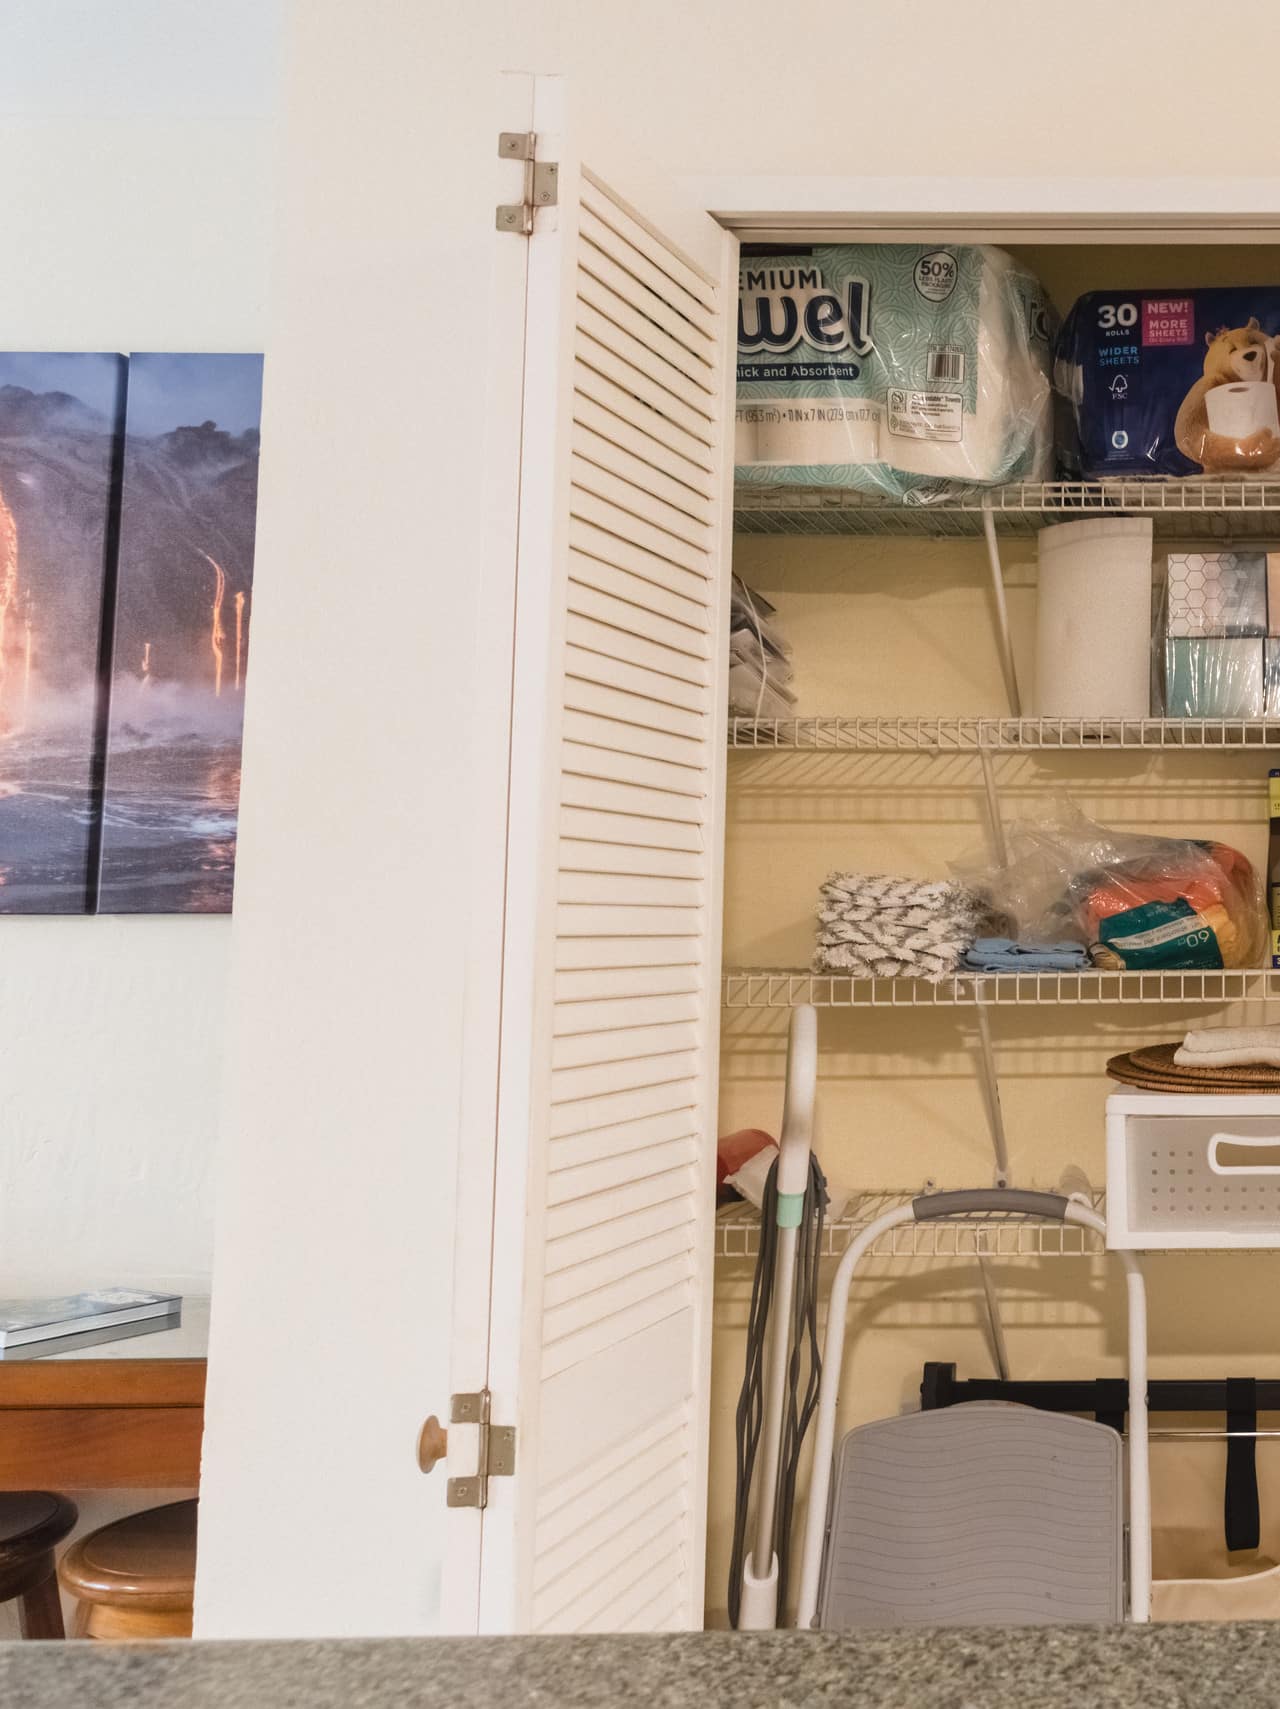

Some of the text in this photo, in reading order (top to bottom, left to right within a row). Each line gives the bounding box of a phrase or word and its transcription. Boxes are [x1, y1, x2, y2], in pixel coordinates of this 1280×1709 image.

[920, 260, 954, 278] 50%
[1147, 302, 1188, 314] NEW!
[1098, 303, 1138, 328] 30
[1149, 319, 1188, 330] MORE
[1149, 329, 1188, 338] SHEETS
[1099, 346, 1138, 357] WIDER
[1100, 356, 1140, 367] SHEETS
[763, 366, 787, 377] and
[791, 366, 854, 377] Absorbent
[1277, 957, 1280, 965] 3
